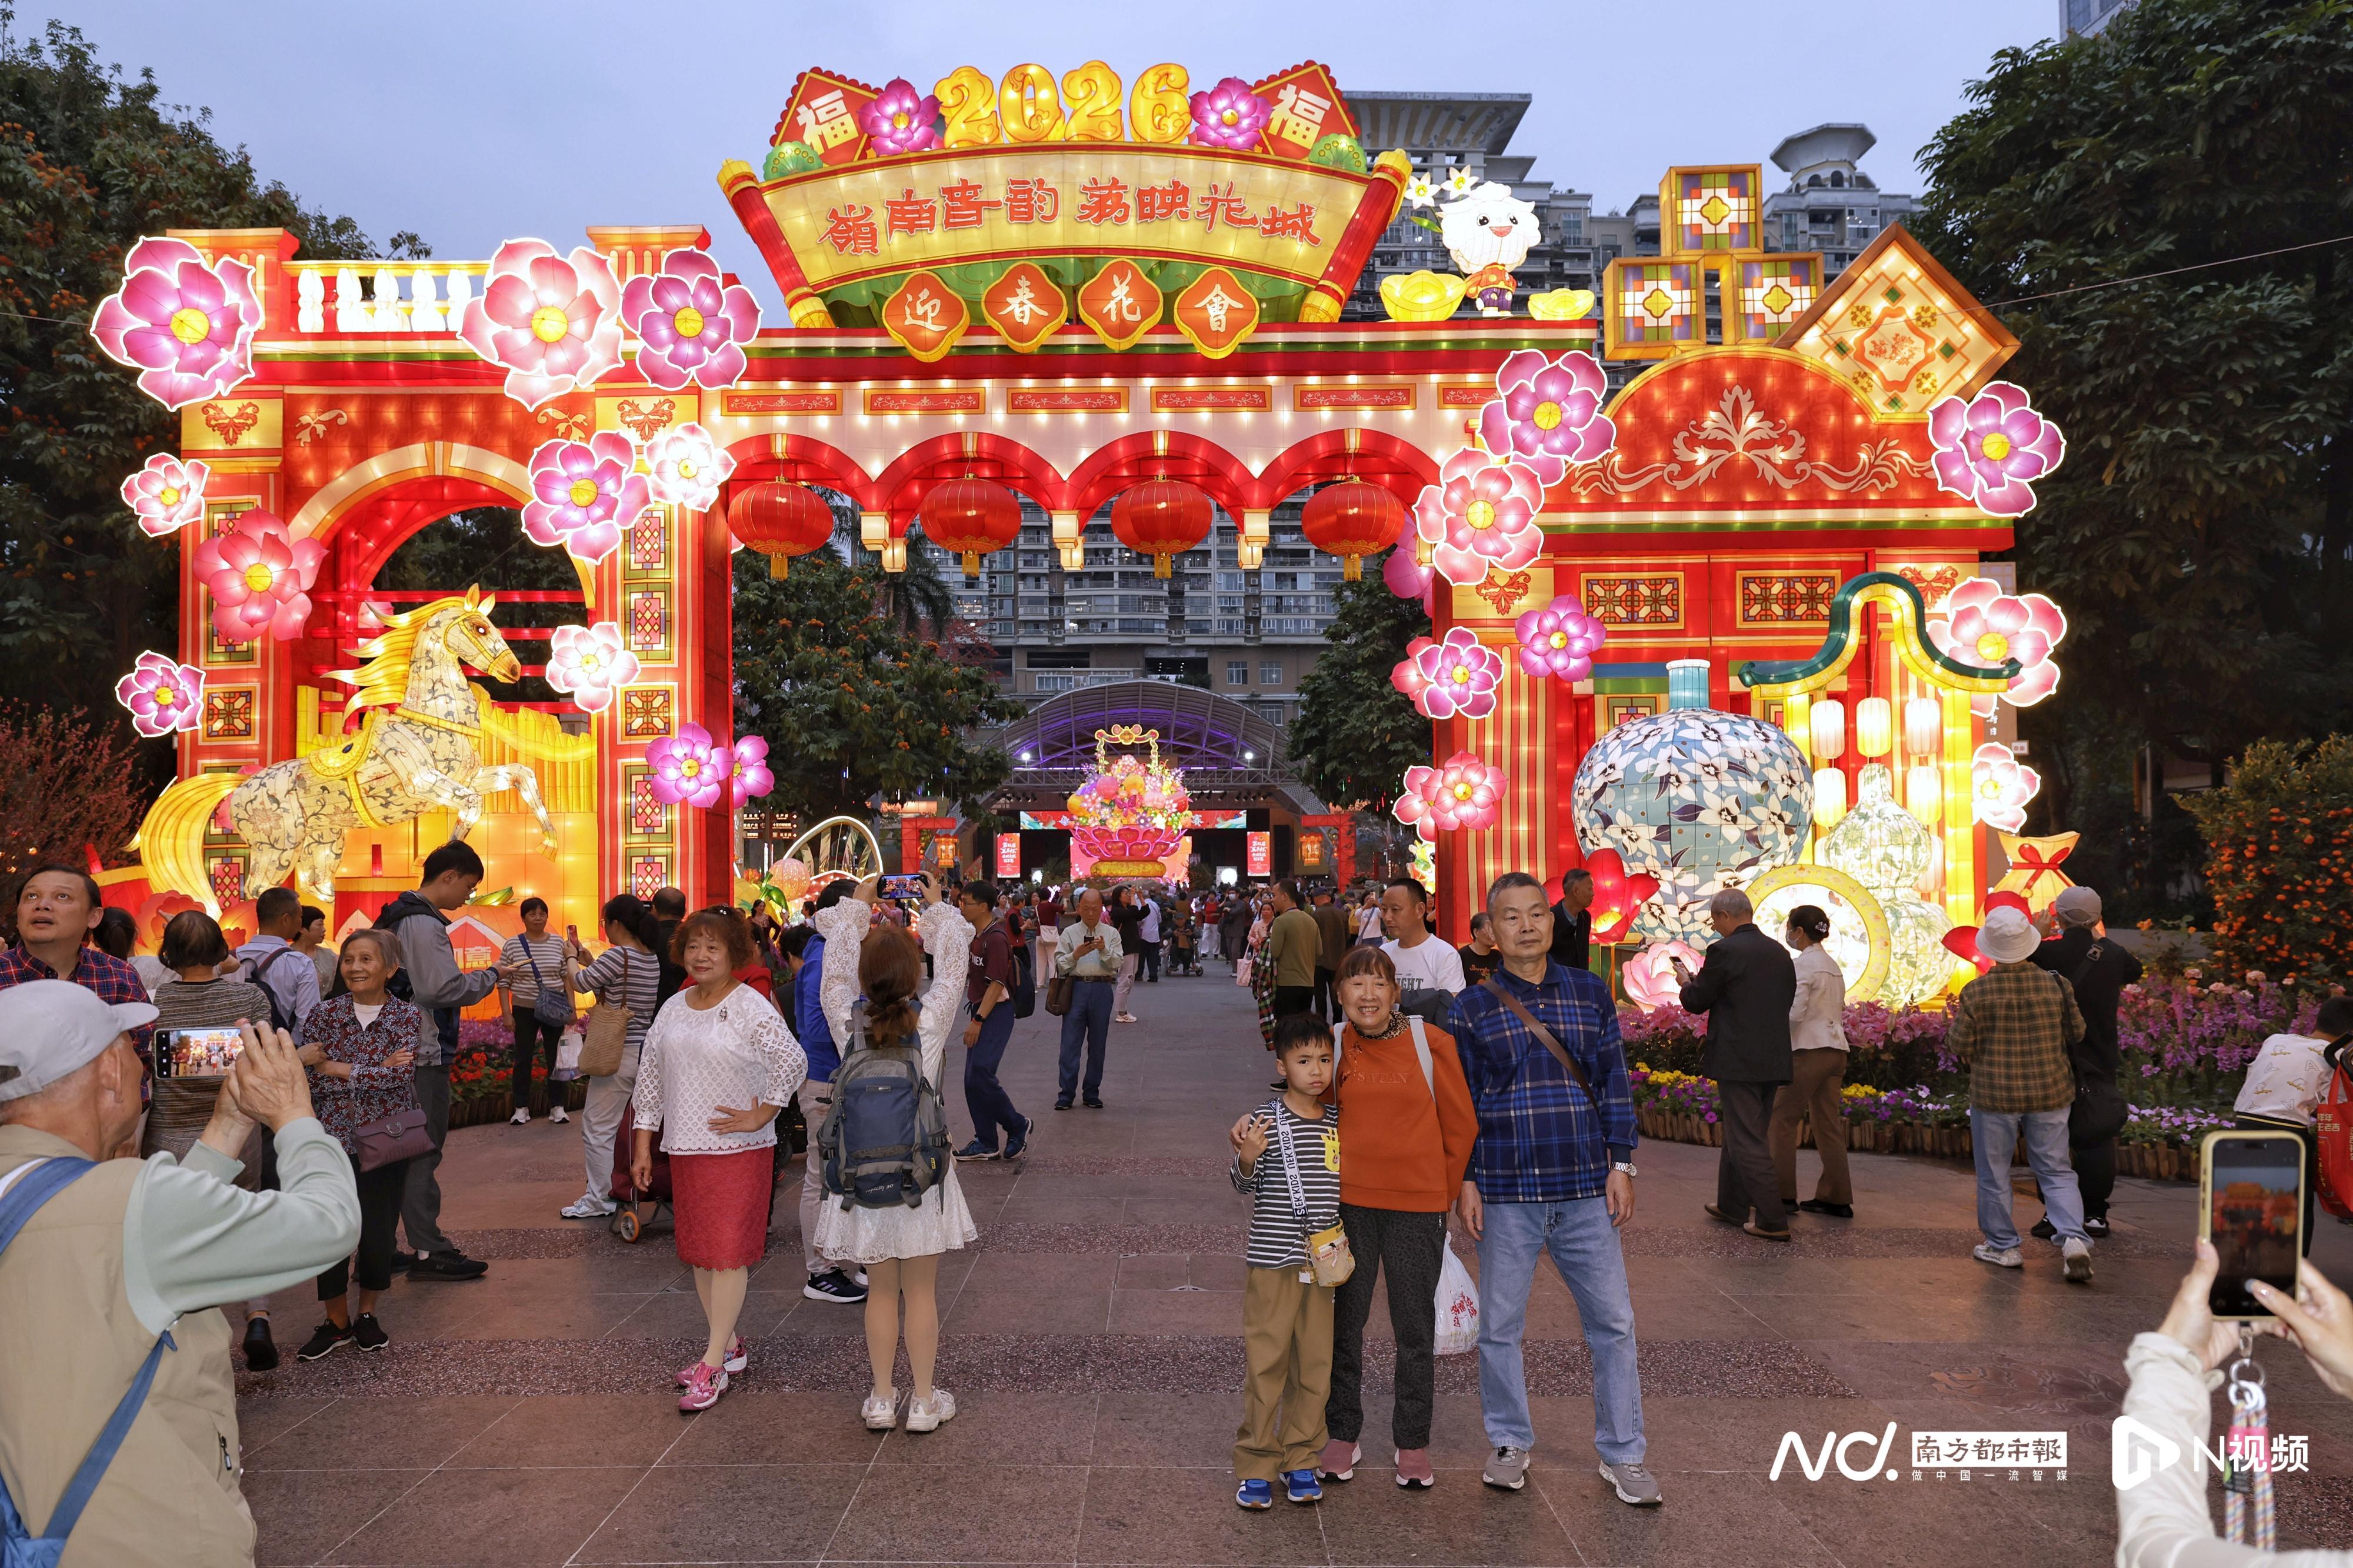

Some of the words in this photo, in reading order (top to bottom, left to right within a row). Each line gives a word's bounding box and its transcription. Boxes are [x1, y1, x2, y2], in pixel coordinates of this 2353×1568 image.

[796, 88, 856, 155] 福
[934, 60, 1192, 148] 2026
[1269, 84, 1332, 149] 福
